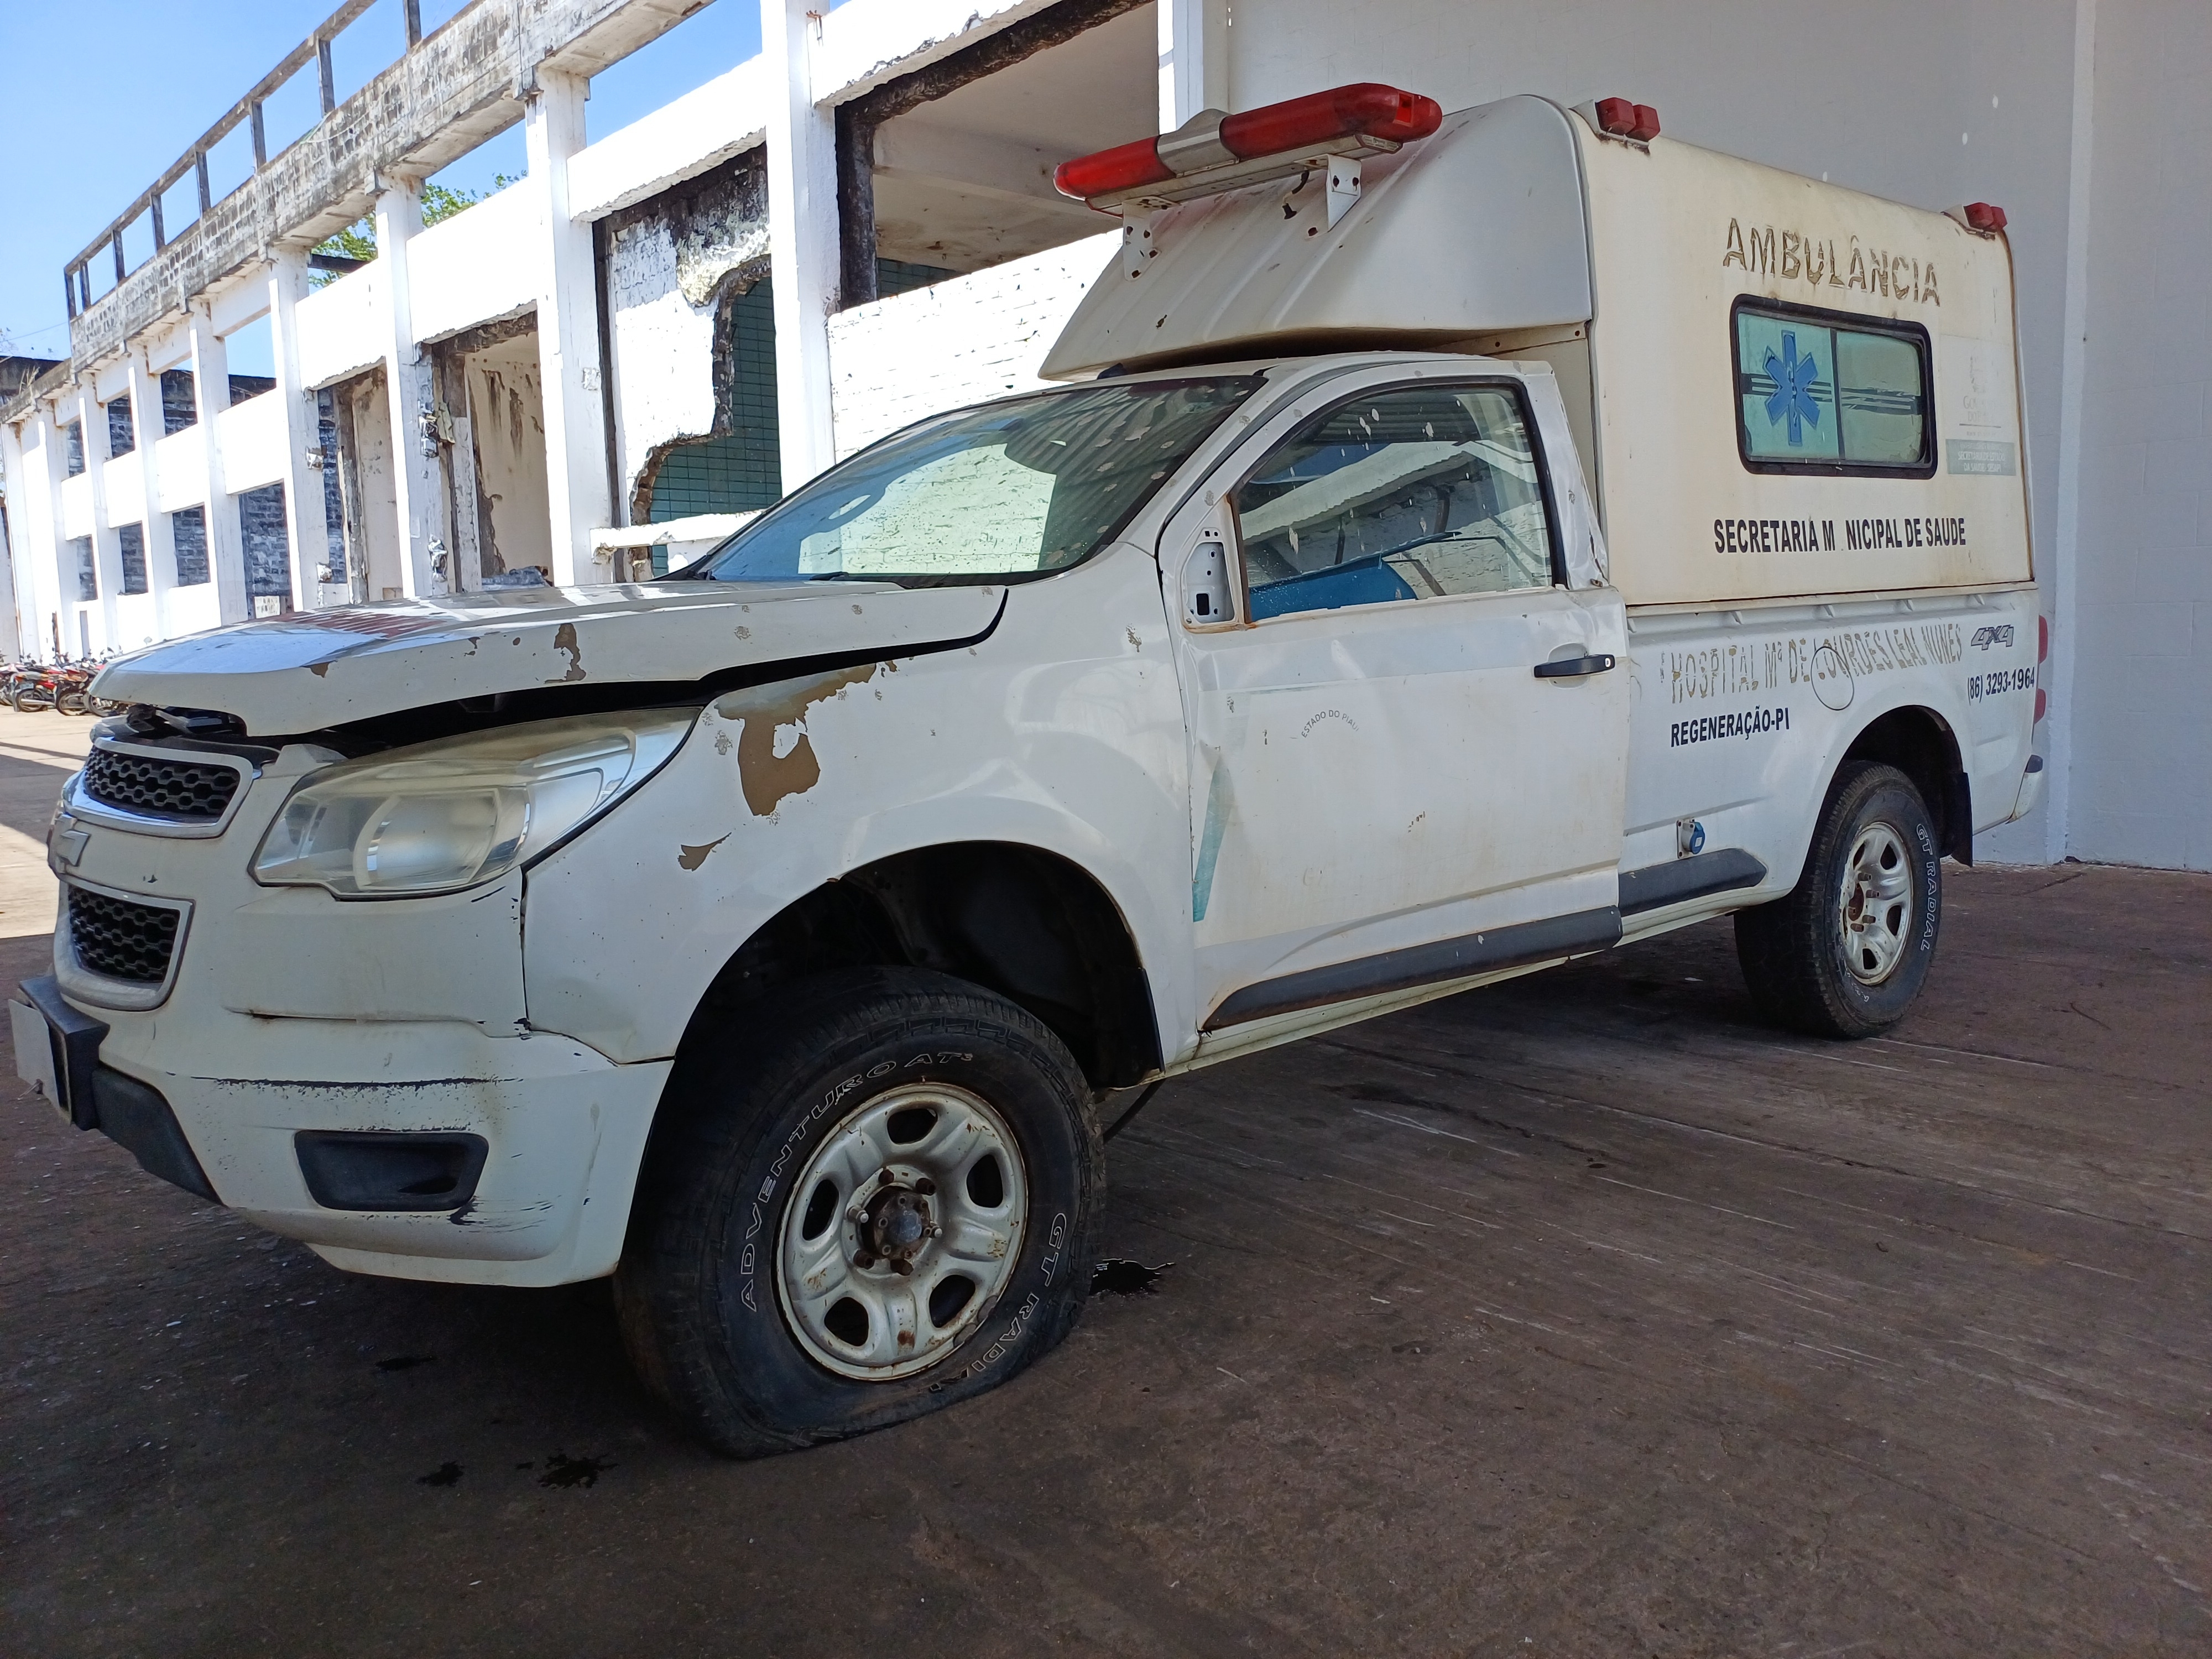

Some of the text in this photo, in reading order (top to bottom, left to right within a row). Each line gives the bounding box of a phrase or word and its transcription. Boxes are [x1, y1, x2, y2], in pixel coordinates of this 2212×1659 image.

[1723, 217, 1940, 307] AMBULÂNCIA
[1714, 518, 1966, 553] SECRETARIA MNICIPAL DE SAUDE
[1671, 644, 1759, 703] HOSPITAL
[1789, 638, 1809, 683] DE
[1814, 630, 1893, 680] LOURDES
[1885, 627, 1927, 669] LEAL
[1921, 623, 1961, 665] NUNES
[1968, 666, 2035, 706] (86) 3293-1964
[1301, 711, 1326, 738] ESTADO
[1328, 709, 1340, 718] DO
[1671, 705, 1790, 747] REGENERAÇÃO-PI
[1916, 823, 1937, 951] GT RADIAL
[740, 1061, 896, 1312] ADVENTURO
[1041, 1213, 1067, 1287] GT
